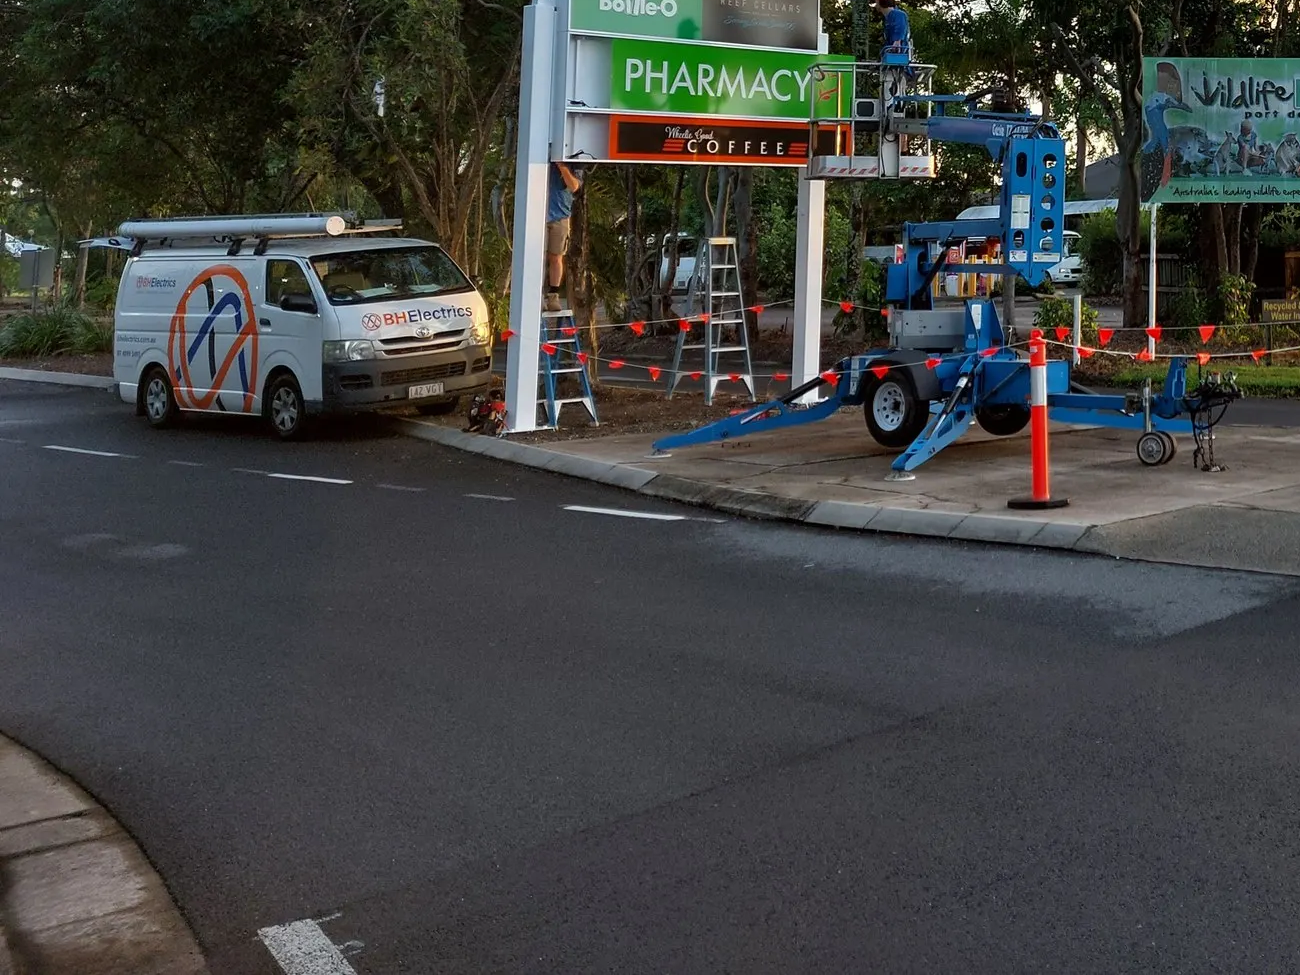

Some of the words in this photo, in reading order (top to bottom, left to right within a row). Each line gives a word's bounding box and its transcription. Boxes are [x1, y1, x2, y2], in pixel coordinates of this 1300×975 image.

[753, 0, 801, 14] CELLARS
[625, 58, 811, 102] PHARMACY
[1190, 71, 1295, 110] Wildlife
[1244, 110, 1278, 120] port
[694, 128, 714, 143] Good
[687, 139, 784, 155] COFFEE
[1222, 185, 1251, 199] leading
[1252, 184, 1281, 196] wildlife
[1263, 301, 1297, 312] Recycled
[383, 305, 473, 326] BHElectrics
[1271, 311, 1292, 321] Water
[425, 383, 442, 394] VGT
